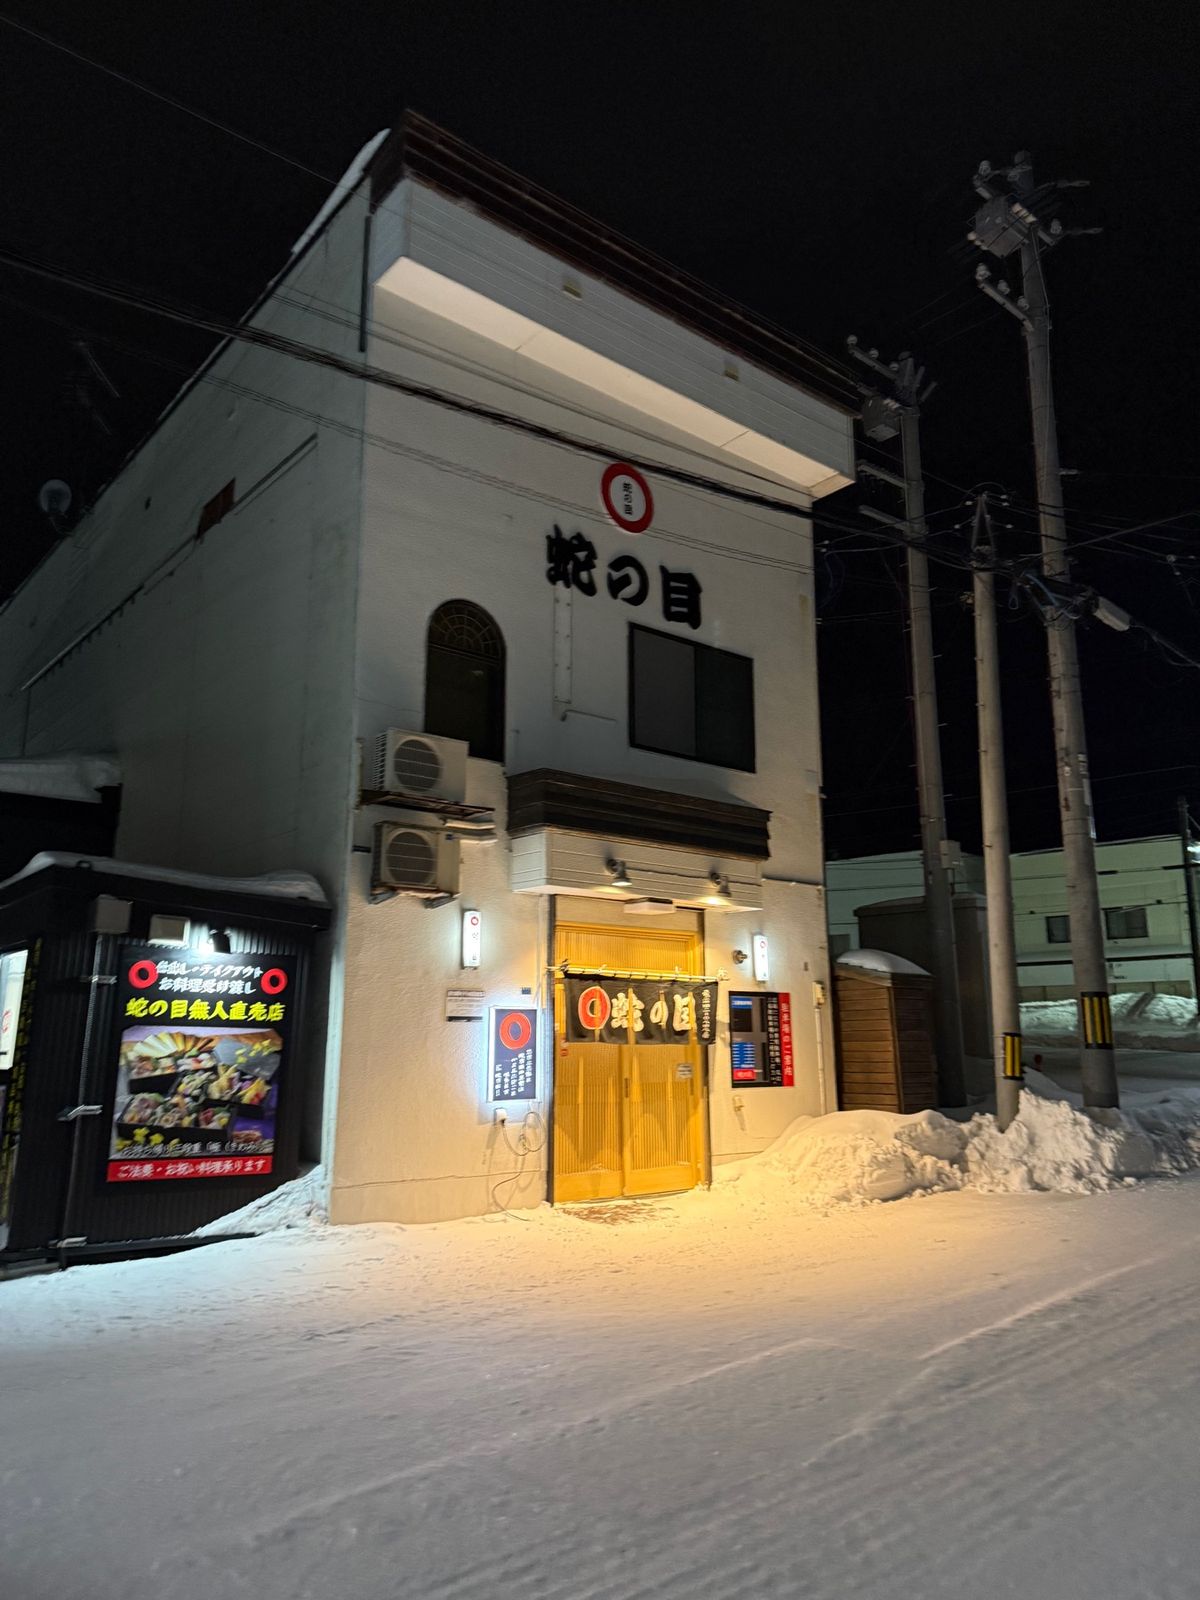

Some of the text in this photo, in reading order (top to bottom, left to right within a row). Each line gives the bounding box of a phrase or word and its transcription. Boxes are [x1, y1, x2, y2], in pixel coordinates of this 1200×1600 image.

[546, 523, 703, 630] 蛇の目
[125, 998, 286, 1022] 蛇の目無人直売店
